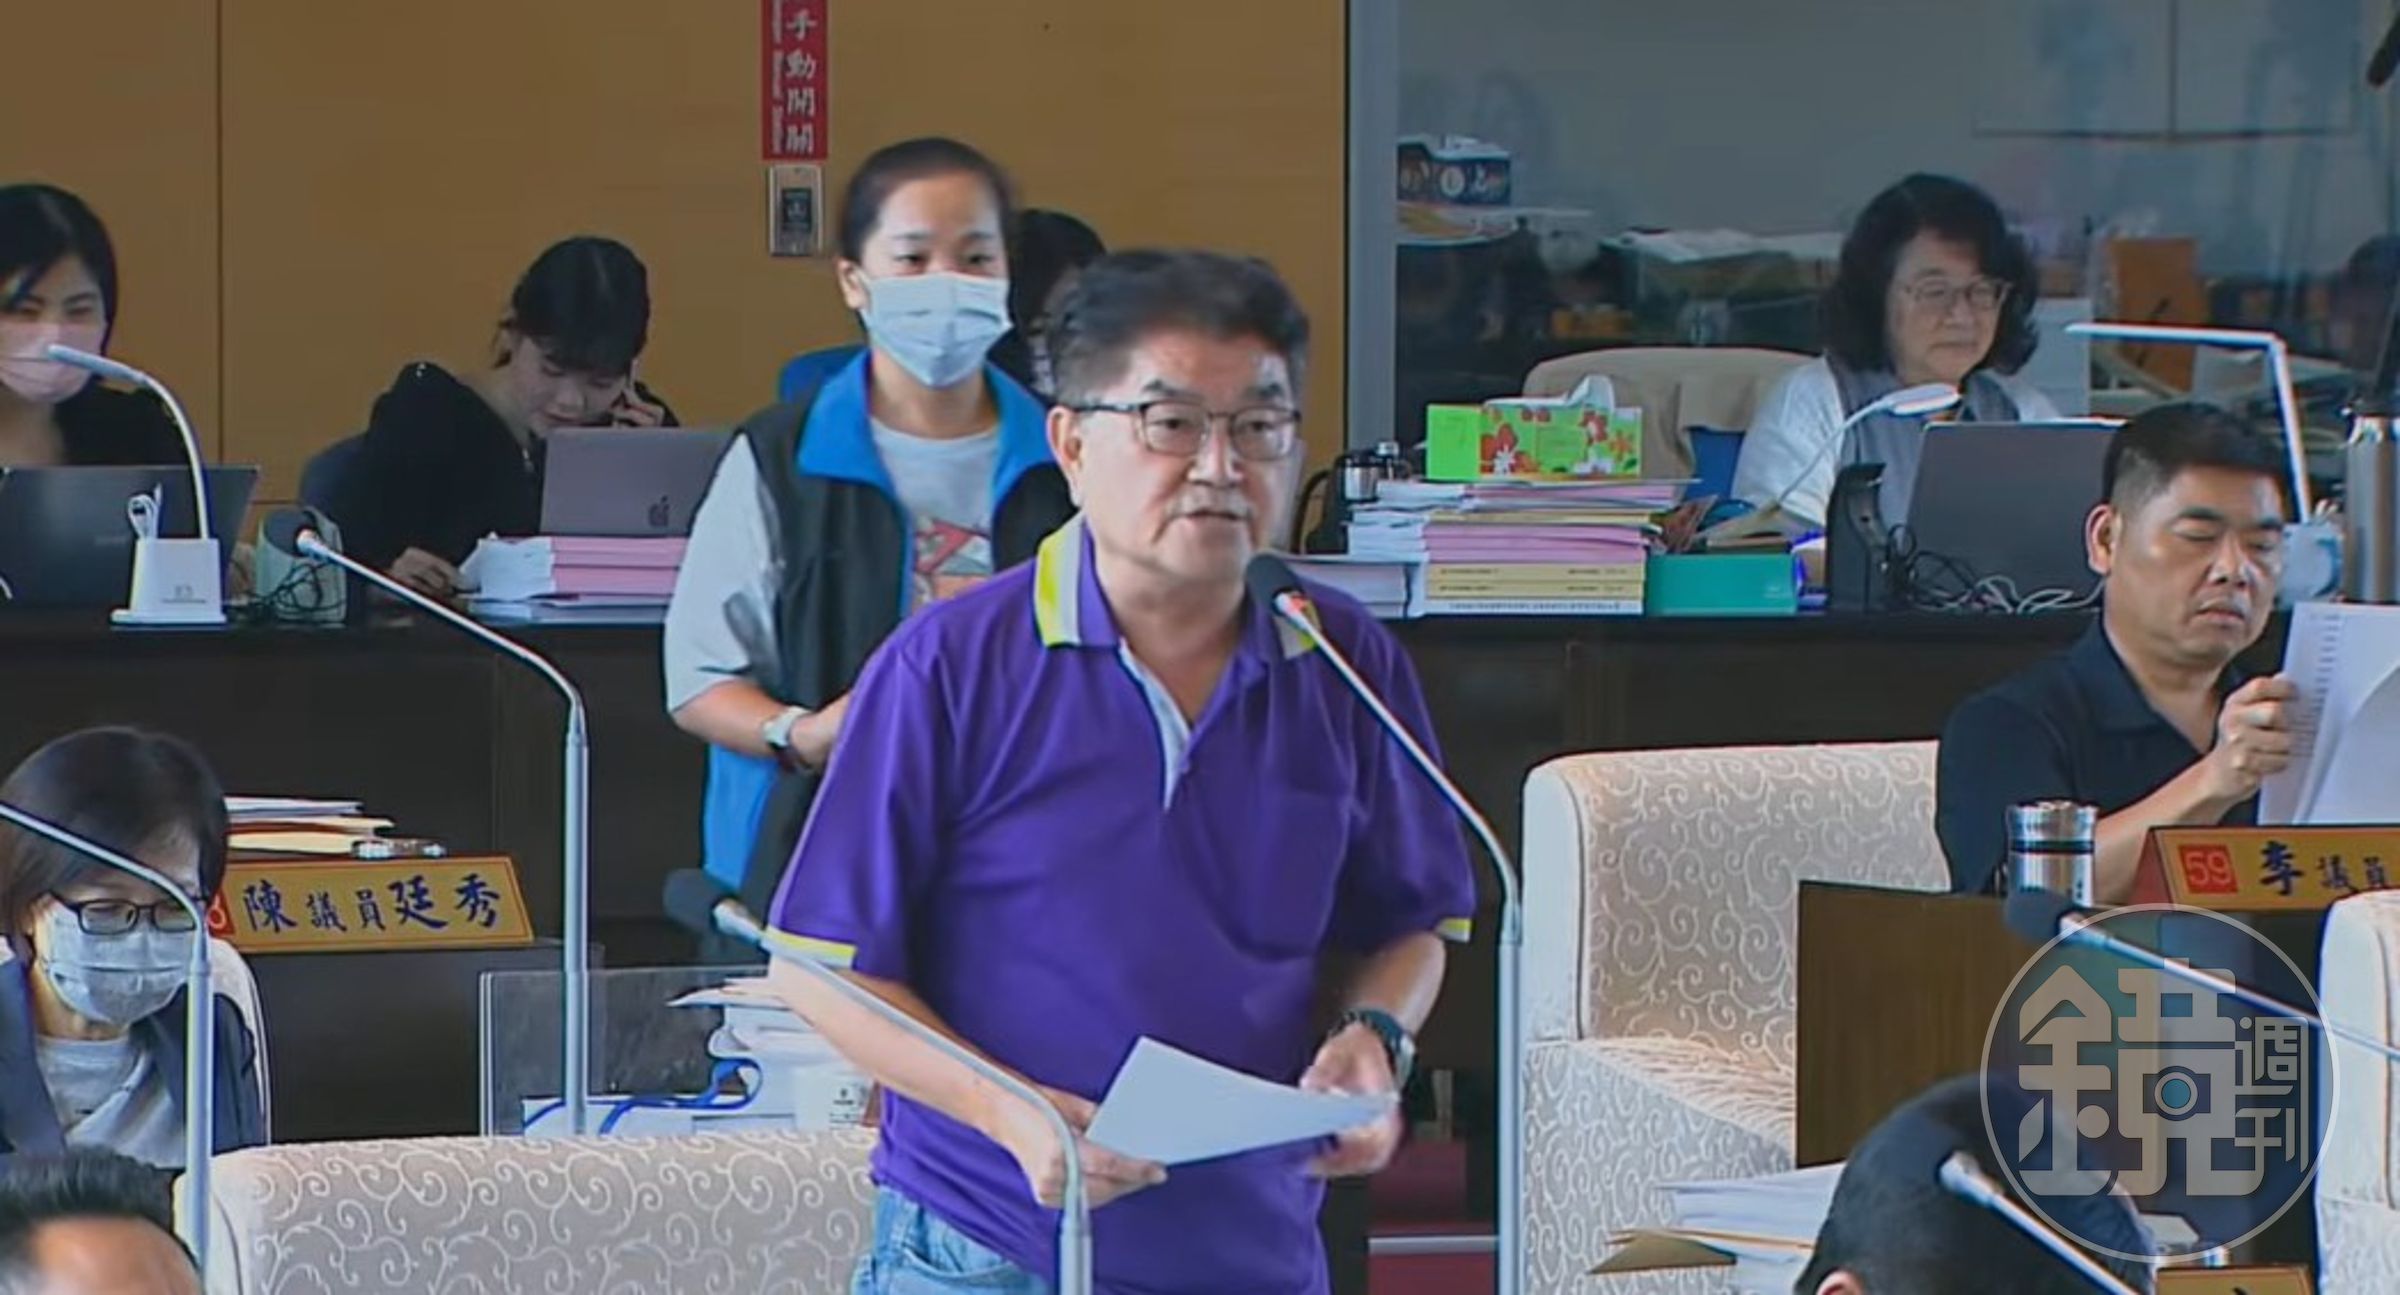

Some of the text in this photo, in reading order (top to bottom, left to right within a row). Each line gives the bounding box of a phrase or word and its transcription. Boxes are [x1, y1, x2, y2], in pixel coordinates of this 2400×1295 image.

[785, 9, 817, 154] 手動開關
[2186, 851, 2232, 886] 59
[243, 872, 501, 933] 陳議員廷秀
